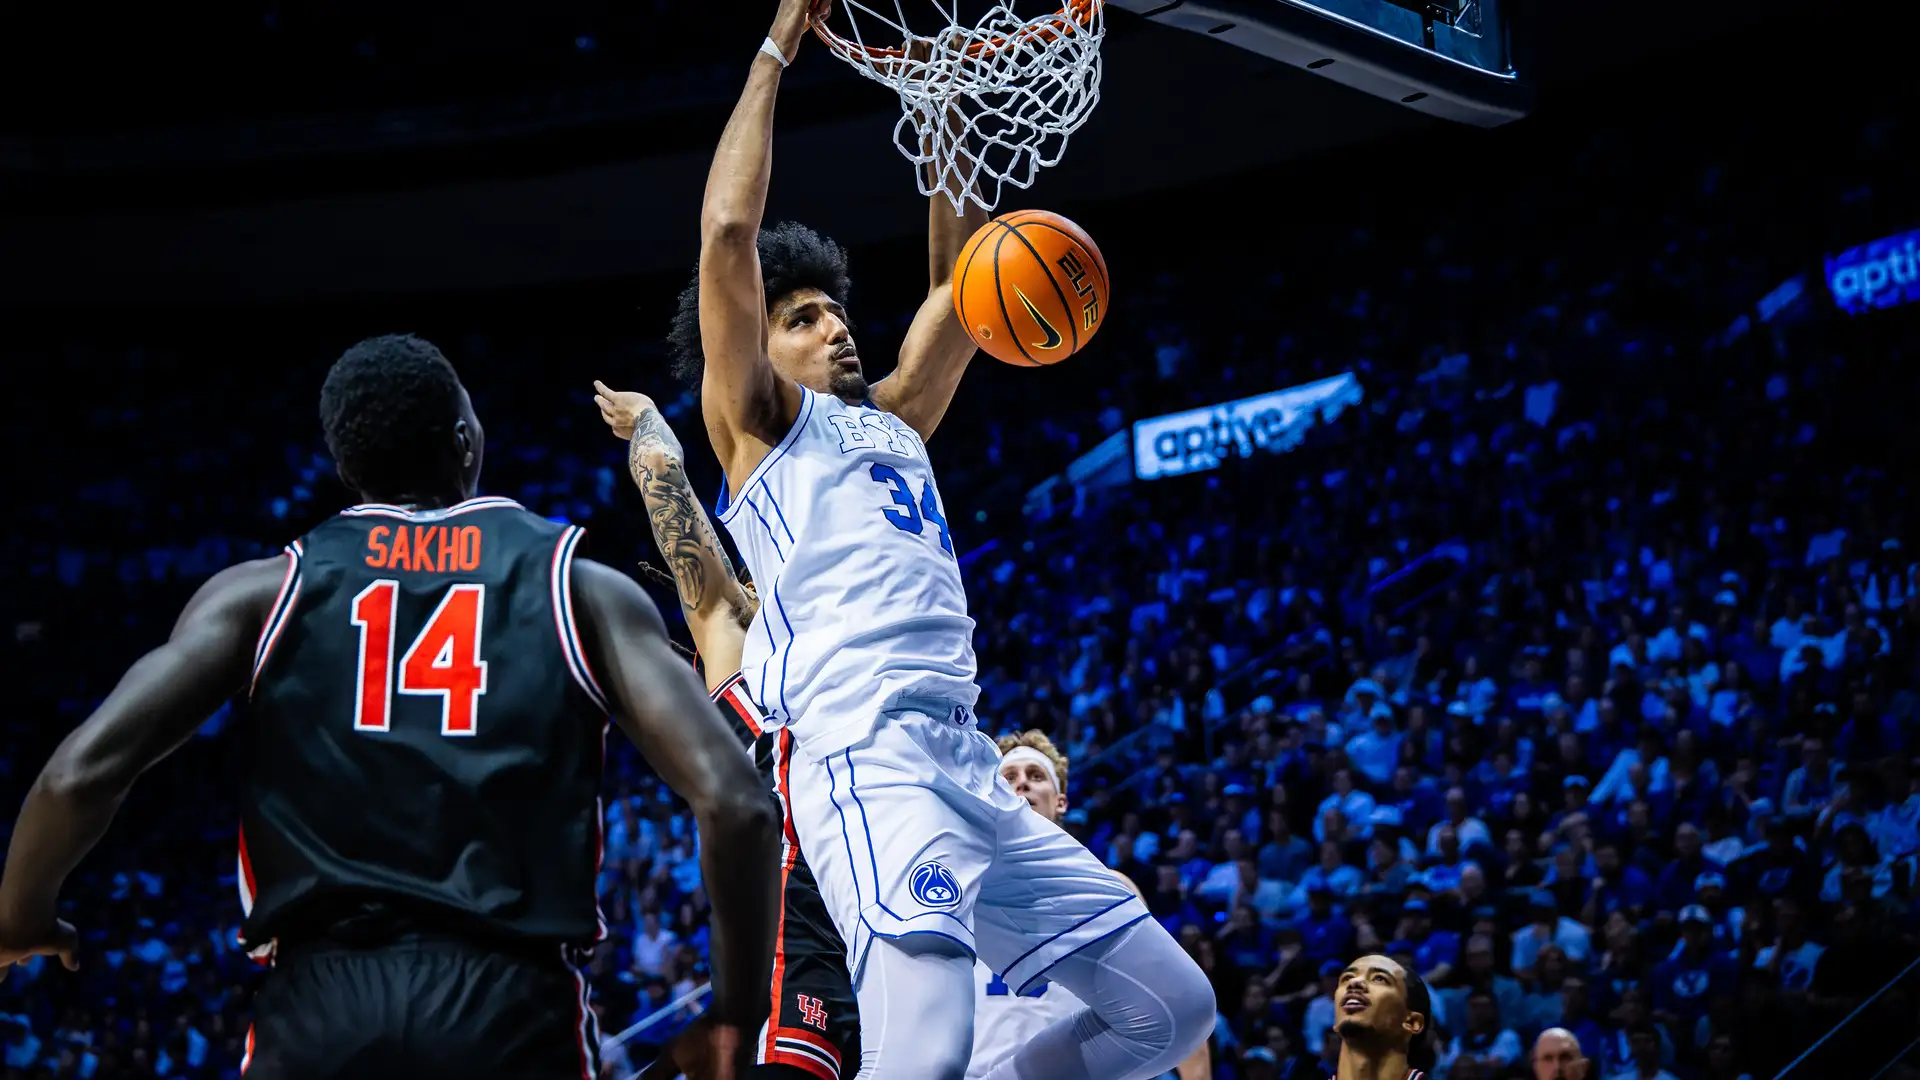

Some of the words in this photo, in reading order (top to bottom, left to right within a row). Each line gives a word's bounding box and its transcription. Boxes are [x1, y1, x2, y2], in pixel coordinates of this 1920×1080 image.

[1056, 248, 1099, 331] ELITE
[1831, 241, 1920, 304] apti
[869, 462, 954, 559] 34
[365, 525, 482, 573] SAKHO
[351, 578, 489, 737] 14
[930, 888, 947, 899] Y
